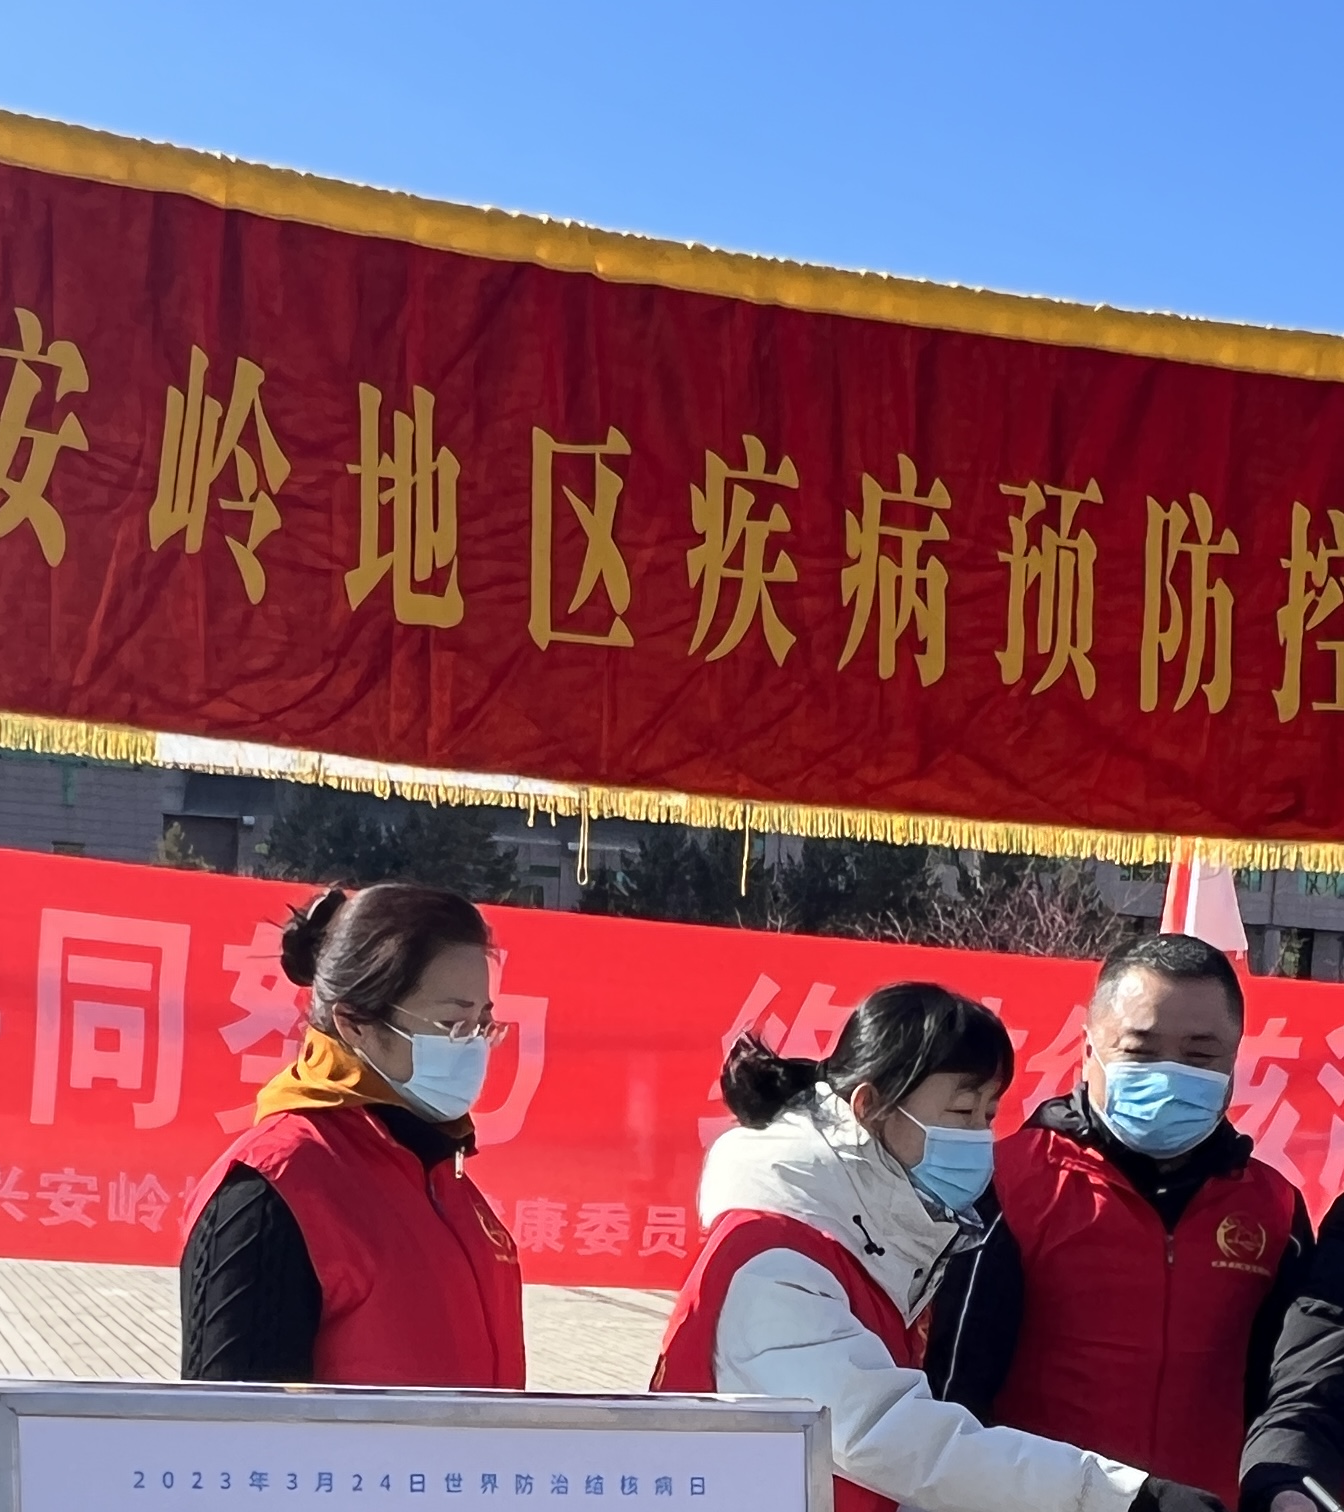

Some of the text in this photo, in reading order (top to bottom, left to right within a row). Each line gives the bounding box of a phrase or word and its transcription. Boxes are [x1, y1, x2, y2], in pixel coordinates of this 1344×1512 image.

[132, 1468, 708, 1498] 2023年3月24日世界防治结核病日
